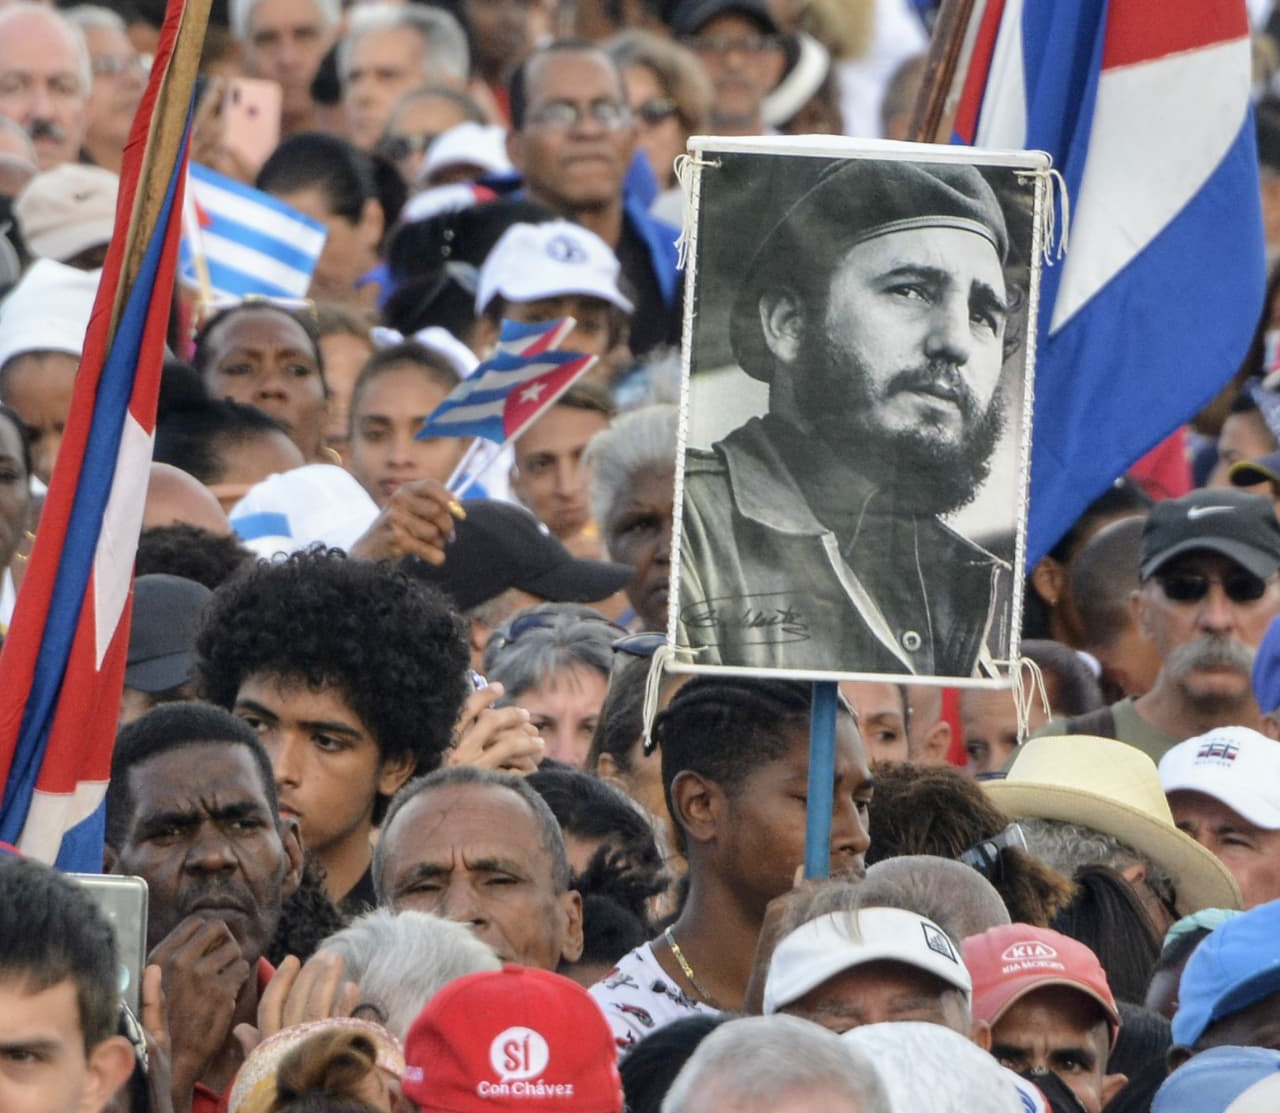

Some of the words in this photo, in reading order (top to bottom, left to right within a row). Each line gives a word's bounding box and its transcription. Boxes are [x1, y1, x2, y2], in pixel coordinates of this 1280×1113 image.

[1012, 946, 1047, 957] KIA
[504, 1034, 531, 1072] SÍ
[478, 1080, 510, 1097] Con
[511, 1078, 575, 1097] Chávez
